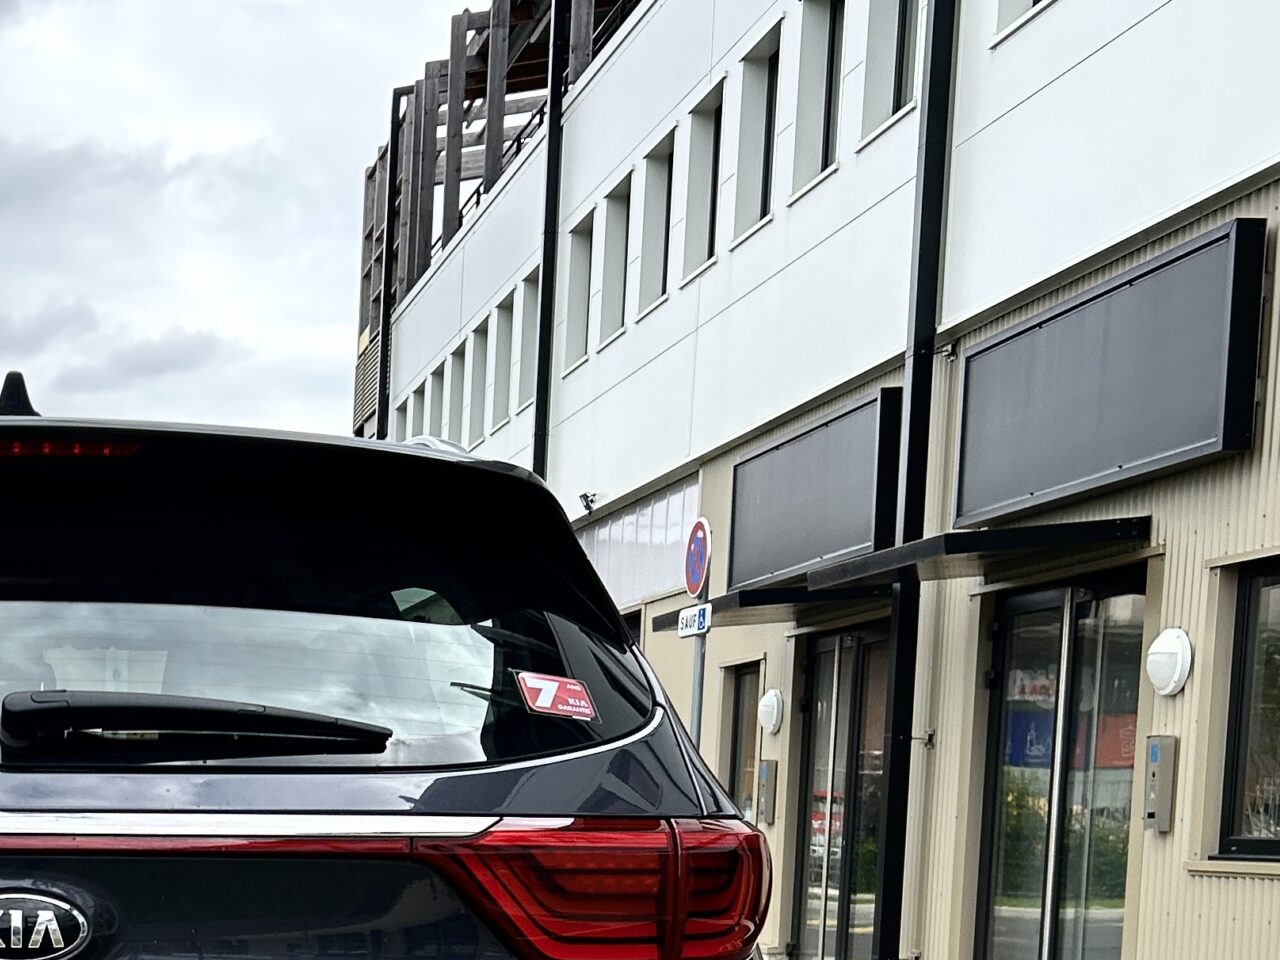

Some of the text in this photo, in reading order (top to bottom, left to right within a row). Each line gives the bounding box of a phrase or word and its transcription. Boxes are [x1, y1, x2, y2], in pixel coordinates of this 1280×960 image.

[680, 613, 697, 631] SAUF
[524, 677, 560, 708] 7
[567, 697, 589, 708] KIA
